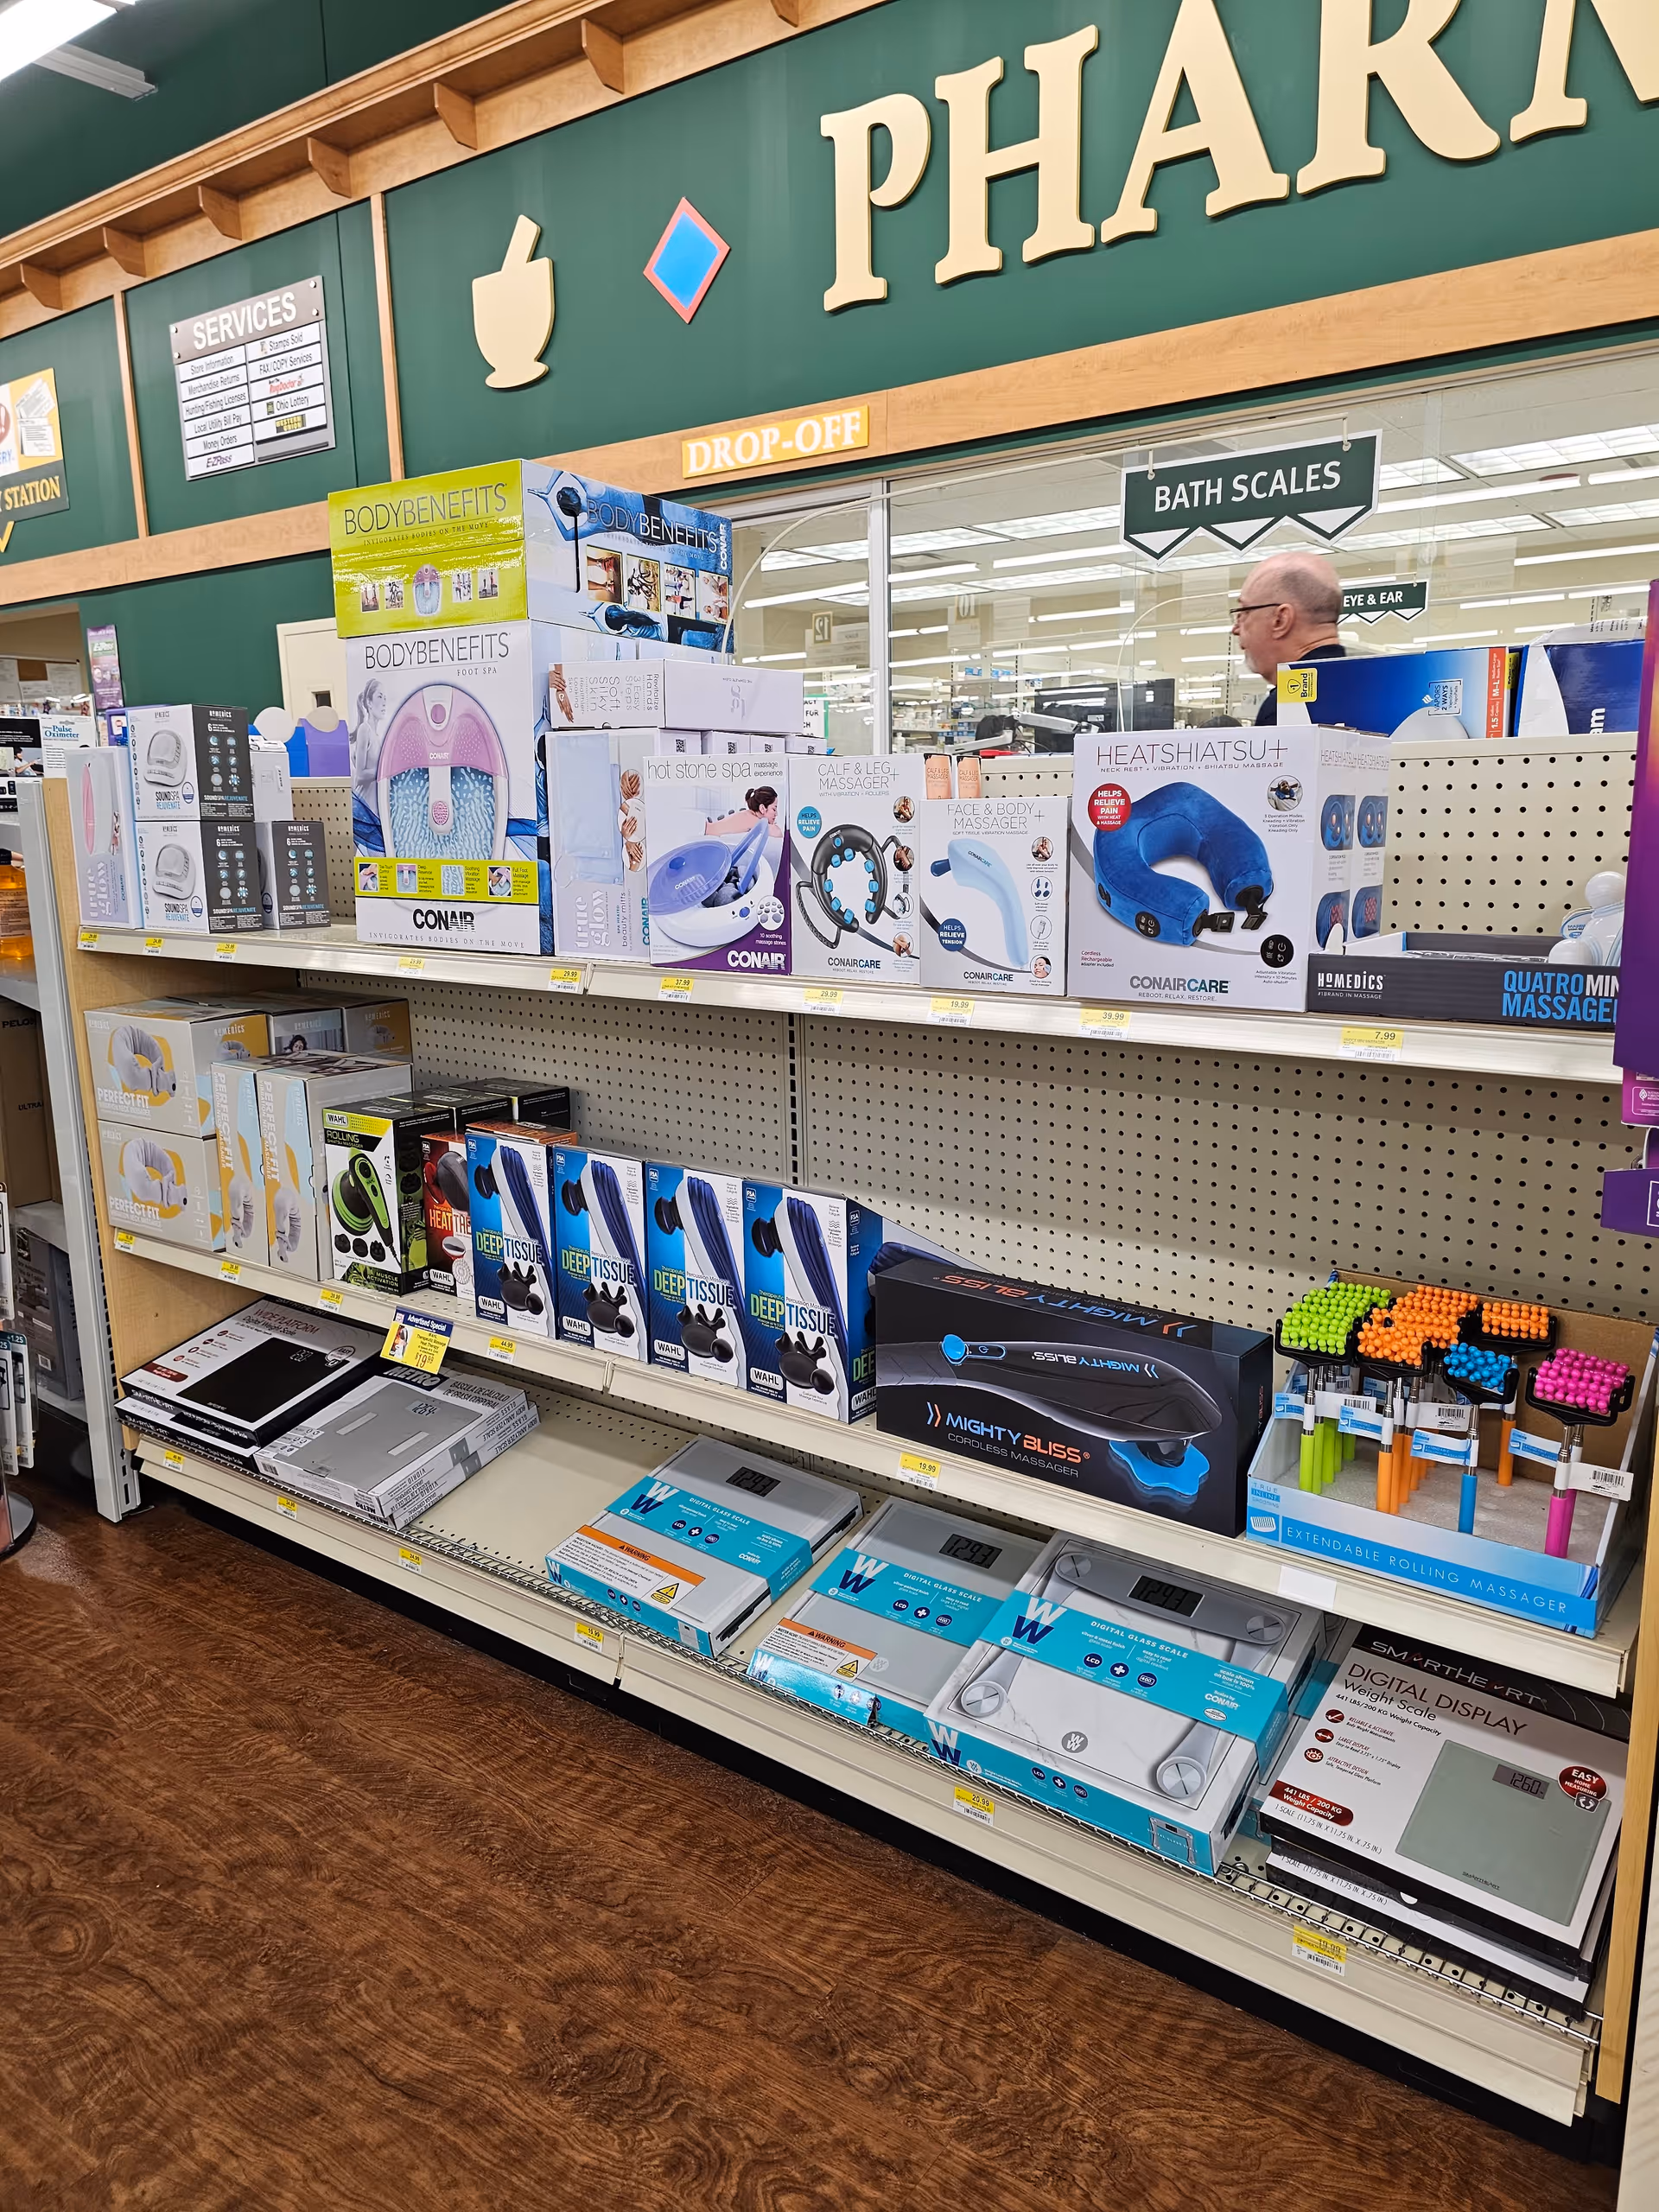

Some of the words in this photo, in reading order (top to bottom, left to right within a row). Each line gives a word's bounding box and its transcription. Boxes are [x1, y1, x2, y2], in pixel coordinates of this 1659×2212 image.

[819, 0, 1659, 314] PHAR
[194, 292, 296, 350] SERVICES
[270, 339, 289, 351] Stamps
[191, 364, 204, 375] Store
[205, 355, 234, 371] Information
[290, 353, 312, 367] Services
[188, 378, 219, 395] Merchandise
[220, 372, 240, 385] Returns
[224, 391, 246, 406] Licenses
[276, 399, 289, 410] Ohio
[290, 395, 309, 408] Lottery
[194, 421, 208, 434] Local
[208, 418, 222, 431] Utility
[233, 413, 242, 426] Pay
[203, 439, 219, 450] Money
[220, 435, 238, 447] Orders
[688, 410, 861, 474] DROP-OFF
[5, 476, 60, 511] STATION
[1155, 478, 1222, 512] BATH
[1231, 461, 1340, 502] SCALES
[345, 483, 507, 535] BODYBENEFITS
[587, 499, 717, 553] BODYBENEFITS
[1343, 594, 1364, 607] EYE
[1367, 593, 1376, 605] &
[1379, 591, 1403, 604] EAR
[365, 632, 511, 670] BODYBENEFITS
[457, 668, 479, 677] FOOT
[482, 666, 498, 675] SPA
[589, 677, 598, 712] Skin
[598, 676, 608, 712] Silky
[609, 676, 620, 712] Soft,
[44, 730, 79, 738] Oximeter
[1097, 739, 1288, 766] HEATSHIATSU+
[648, 760, 671, 779] hot
[676, 760, 717, 779] stone
[722, 762, 751, 782] spa
[818, 763, 850, 776] CALF
[854, 762, 862, 774] &
[866, 761, 891, 775] LEG
[819, 776, 889, 790] MASSAGER
[947, 804, 980, 816] FACE
[984, 803, 993, 815] &
[996, 802, 1035, 815] BODY
[953, 816, 1027, 830] MASSAGER
[413, 908, 476, 933] CONAIR
[642, 897, 650, 946] CONAIR
[369, 932, 424, 942] INVIGORATES
[728, 950, 785, 970] CONAIR
[828, 957, 881, 969] CONAIRCARE
[963, 971, 1014, 982] CONAIRCARE
[1130, 976, 1230, 994] CONAIRCARE
[1503, 970, 1584, 996] QUATRO
[950, 1001, 969, 1009] 19.99
[1502, 993, 1618, 1023] MASSAGE
[1102, 1011, 1125, 1021] 39.99
[1374, 1031, 1396, 1041] 7.99
[97, 1087, 136, 1107] PERFECT
[137, 1095, 149, 1109] FIT
[327, 1114, 346, 1124] WAHL
[327, 1131, 359, 1144] ROLLING
[109, 1195, 146, 1218] PERFECT
[147, 1207, 159, 1220] FIT
[429, 1209, 452, 1231] HEAT
[476, 1231, 503, 1257] DEEP
[504, 1237, 543, 1265] TISSUE
[376, 1271, 398, 1282] MUSCLE
[562, 1249, 591, 1275] DEEP
[591, 1256, 635, 1286] TISSUE
[367, 1275, 399, 1287] ACTIVATION
[654, 1269, 686, 1297] DEEP
[687, 1277, 734, 1308] TISSUE
[940, 1275, 1030, 1298] BLISS
[482, 1297, 502, 1310] WAHL
[1024, 1294, 1159, 1326] MIGHTY
[277, 1314, 320, 1335] PLATFORM
[407, 1314, 430, 1326] Advertised
[430, 1321, 447, 1332] Special
[566, 1318, 588, 1332] WAHL
[750, 1294, 785, 1323] DEEP
[786, 1303, 836, 1338] TISSUE
[500, 1340, 513, 1349] 44.99
[658, 1342, 682, 1357] WAHL
[1033, 1351, 1077, 1364] BLISS
[1079, 1356, 1141, 1373] MIGHTY
[383, 1366, 441, 1387] METRO
[754, 1370, 779, 1386] WAHL
[946, 1413, 1022, 1445] MIGHTY
[1023, 1434, 1082, 1464] BLISS
[947, 1433, 1008, 1457] CORDLESS
[1011, 1450, 1079, 1478] MASSAGER
[407, 1468, 426, 1484] VIDRIO
[918, 1462, 937, 1473] 19.99
[647, 1481, 680, 1500] W
[1254, 1482, 1278, 1494] TRUE
[409, 1553, 420, 1562] 24.99
[622, 1544, 651, 1562] WARNING
[1287, 1527, 1380, 1562] EXTENDABLE
[1389, 1556, 1459, 1583] ROLLING
[1470, 1579, 1567, 1613] MASSAGER
[903, 1573, 931, 1586] DIGITAL
[934, 1583, 957, 1594] GLASS
[958, 1591, 982, 1602] SCALE
[814, 1630, 846, 1649] WARNING
[1090, 1621, 1125, 1637] DIGITAL
[1128, 1633, 1157, 1647] GLASS
[1159, 1644, 1189, 1659] SCALE
[1086, 1656, 1100, 1665] LCD
[1205, 1693, 1239, 1710] CONAIR
[1344, 1679, 1394, 1706] Weight
[1397, 1700, 1437, 1721] Scale
[1348, 1663, 1427, 1703] DIGITAL
[1435, 1693, 1528, 1736] DISPLAY
[1389, 1711, 1412, 1725] Weight
[1413, 1720, 1442, 1736] Capacity
[1572, 1769, 1599, 1785] EASY
[1574, 1779, 1591, 1789] HOME
[1564, 1780, 1598, 1797] MEASURING
[971, 1794, 991, 1807] 20.99
[1284, 1787, 1297, 1796] 441
[1316, 1800, 1331, 1810] 200
[1306, 1804, 1335, 1820] Capacity
